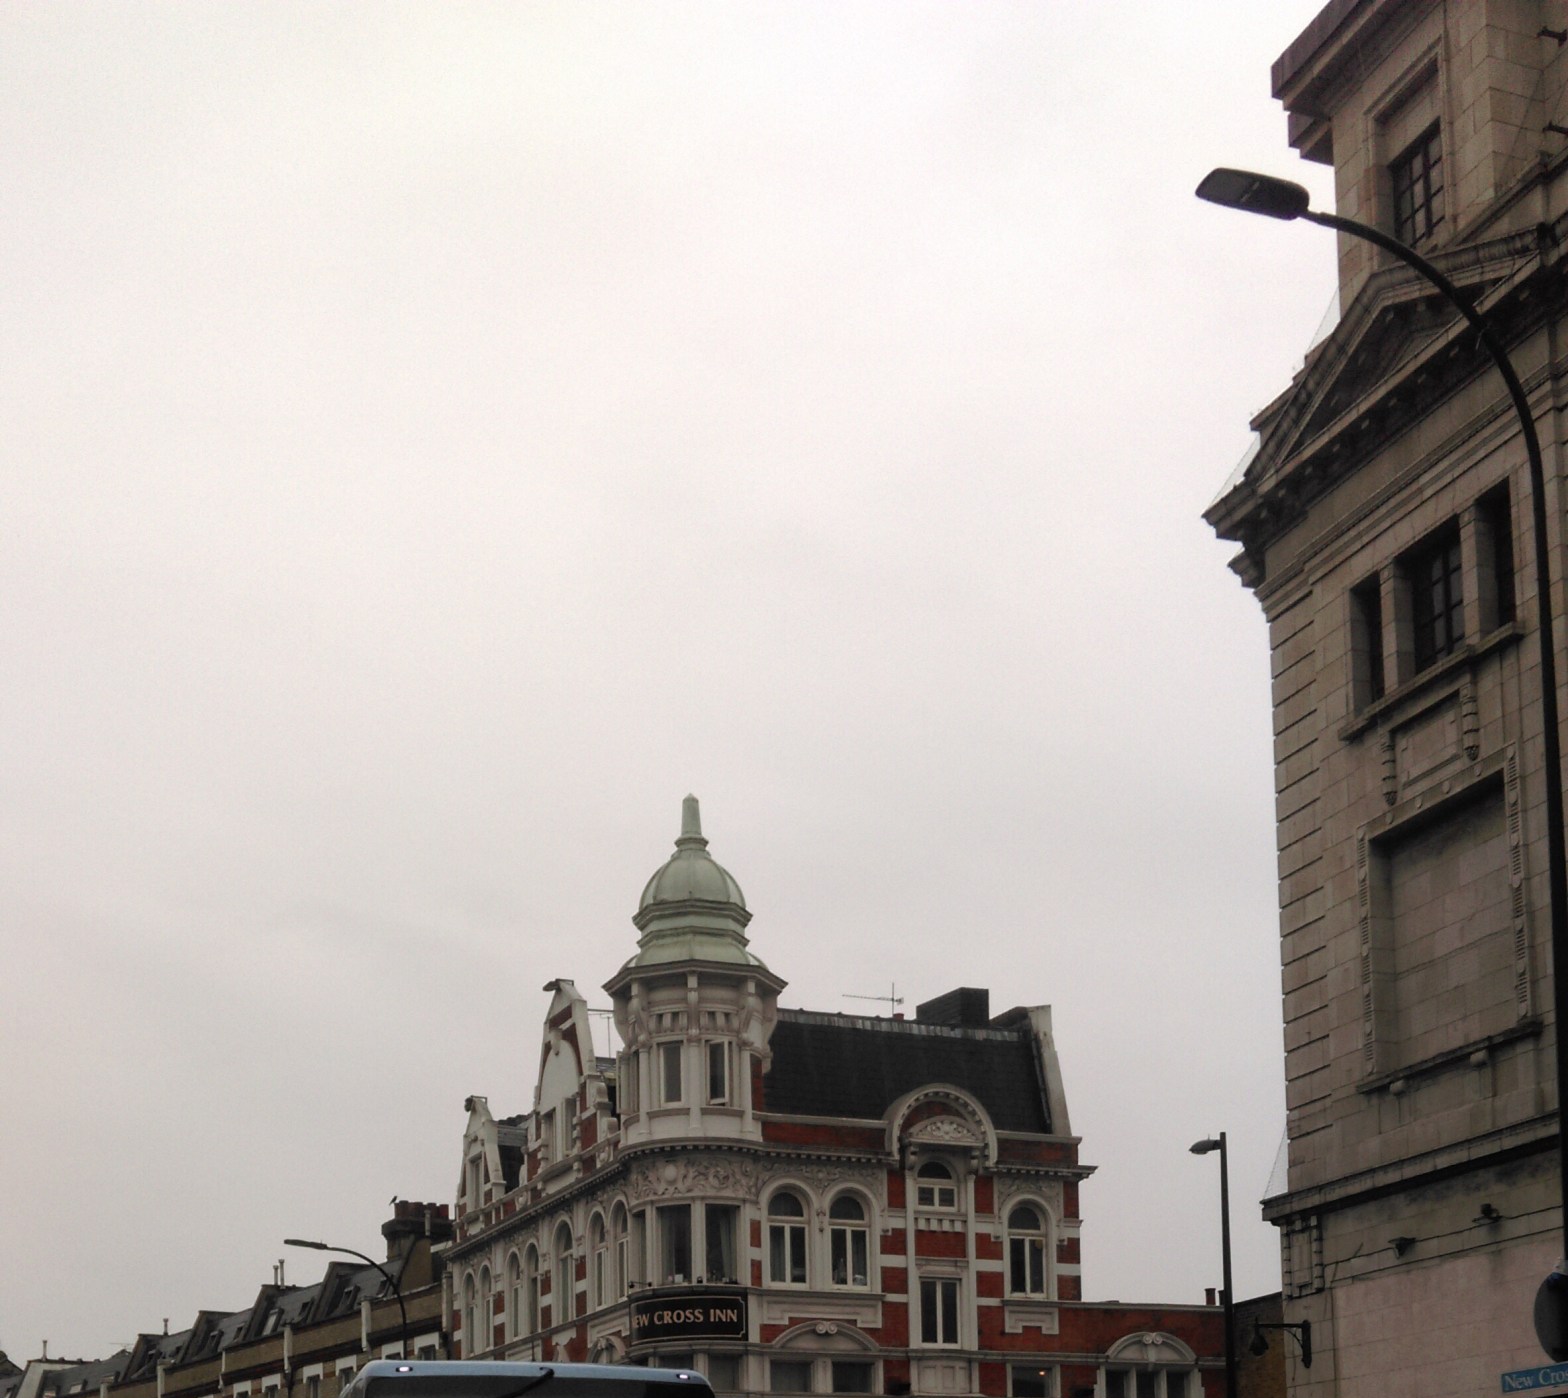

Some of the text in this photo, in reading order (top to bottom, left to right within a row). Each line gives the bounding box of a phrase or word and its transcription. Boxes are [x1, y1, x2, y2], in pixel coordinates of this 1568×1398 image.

[632, 1309, 738, 1328] EW CROSS INN
[1504, 1374, 1534, 1391] New
